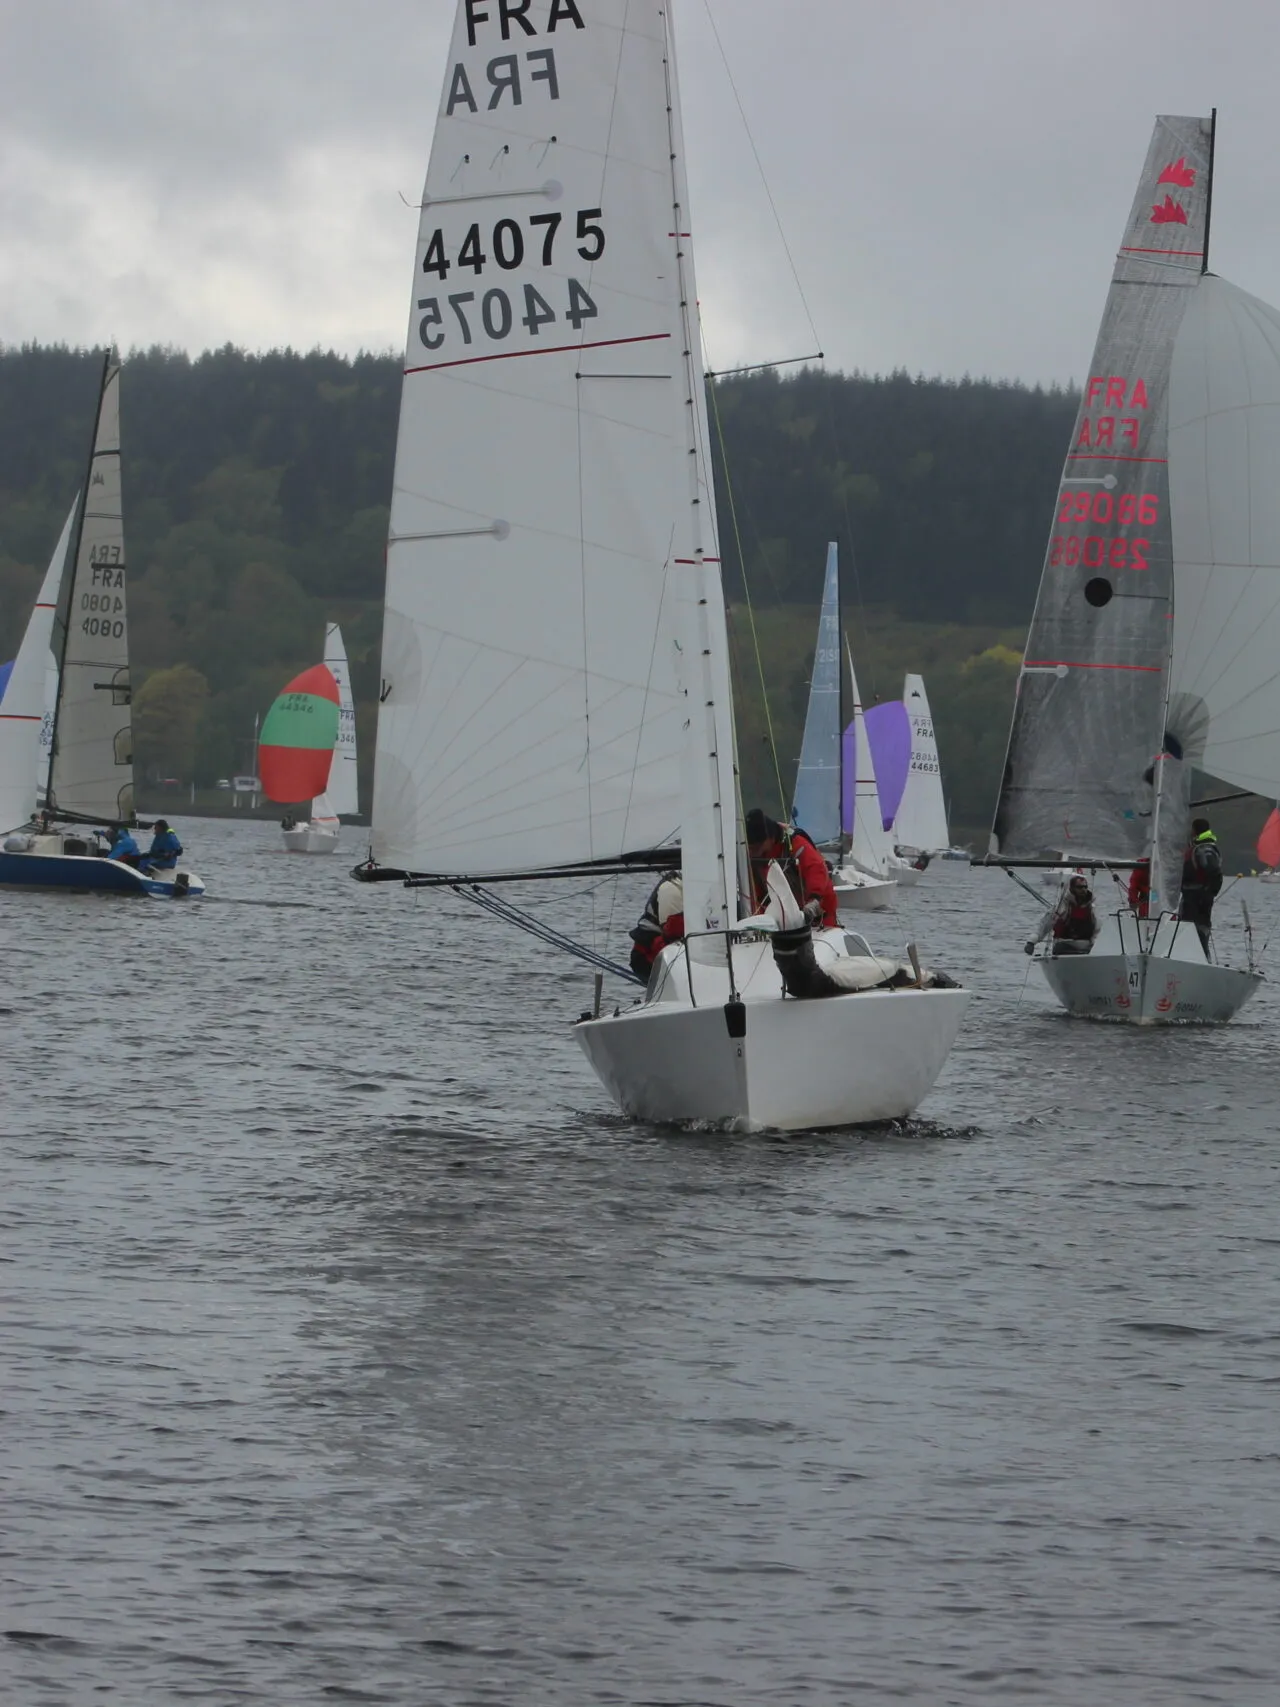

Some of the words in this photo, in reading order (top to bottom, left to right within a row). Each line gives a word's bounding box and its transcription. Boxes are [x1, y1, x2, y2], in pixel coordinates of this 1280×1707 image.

[465, 0, 585, 46] FRA
[422, 208, 605, 280] 44075
[1084, 376, 1150, 409] FRA
[1057, 491, 1159, 525] 29086
[91, 568, 123, 588] FRA
[82, 617, 124, 638] 4080
[916, 728, 934, 738] FRA
[911, 762, 939, 773] 44683
[1128, 972, 1139, 987] 47
